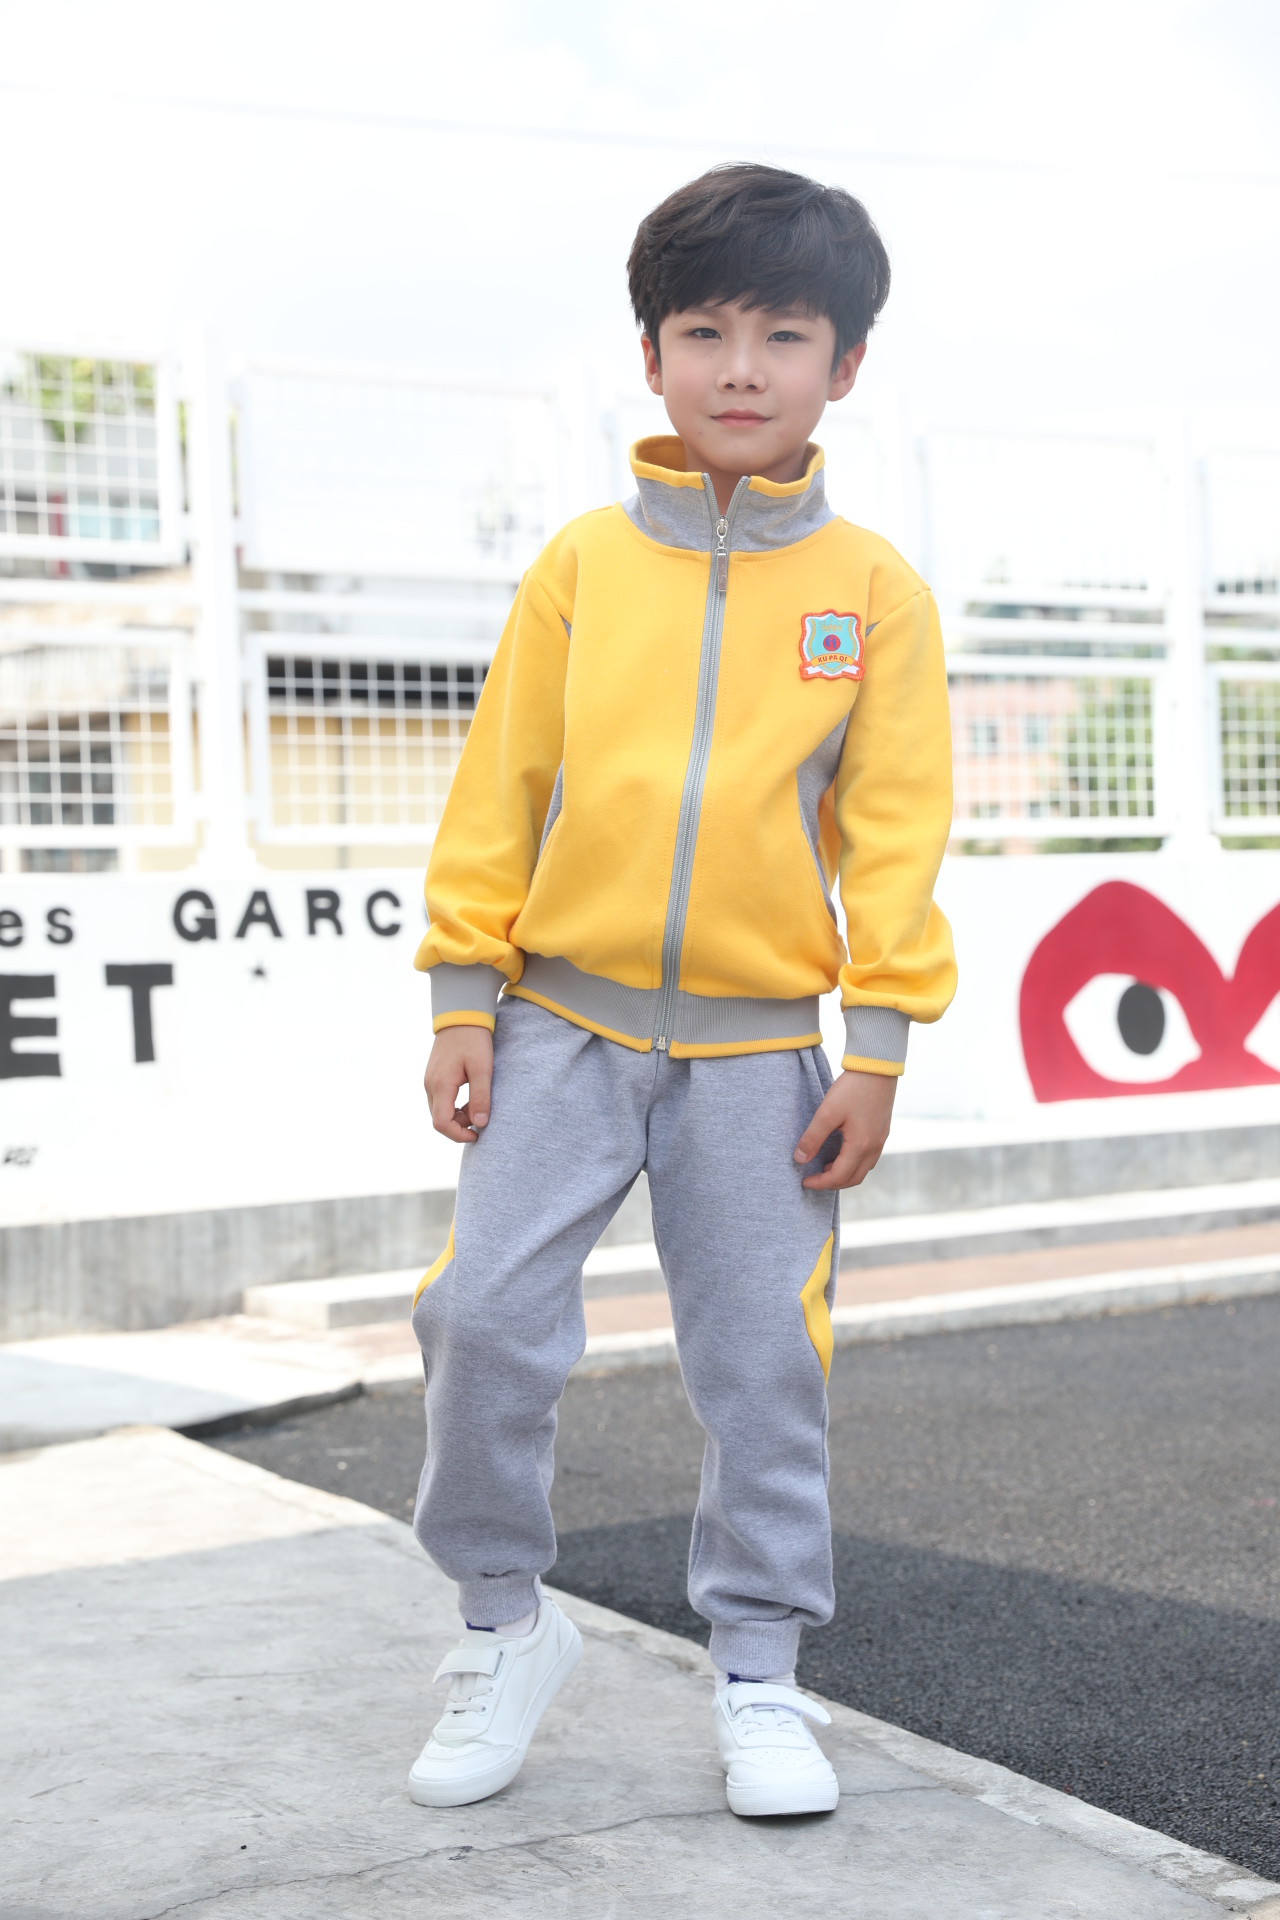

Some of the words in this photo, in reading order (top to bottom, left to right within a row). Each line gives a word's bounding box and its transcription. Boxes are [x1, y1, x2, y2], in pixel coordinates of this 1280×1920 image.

[0, 907, 75, 947] es
[172, 889, 431, 943] GARC
[0, 962, 174, 1080] ET
